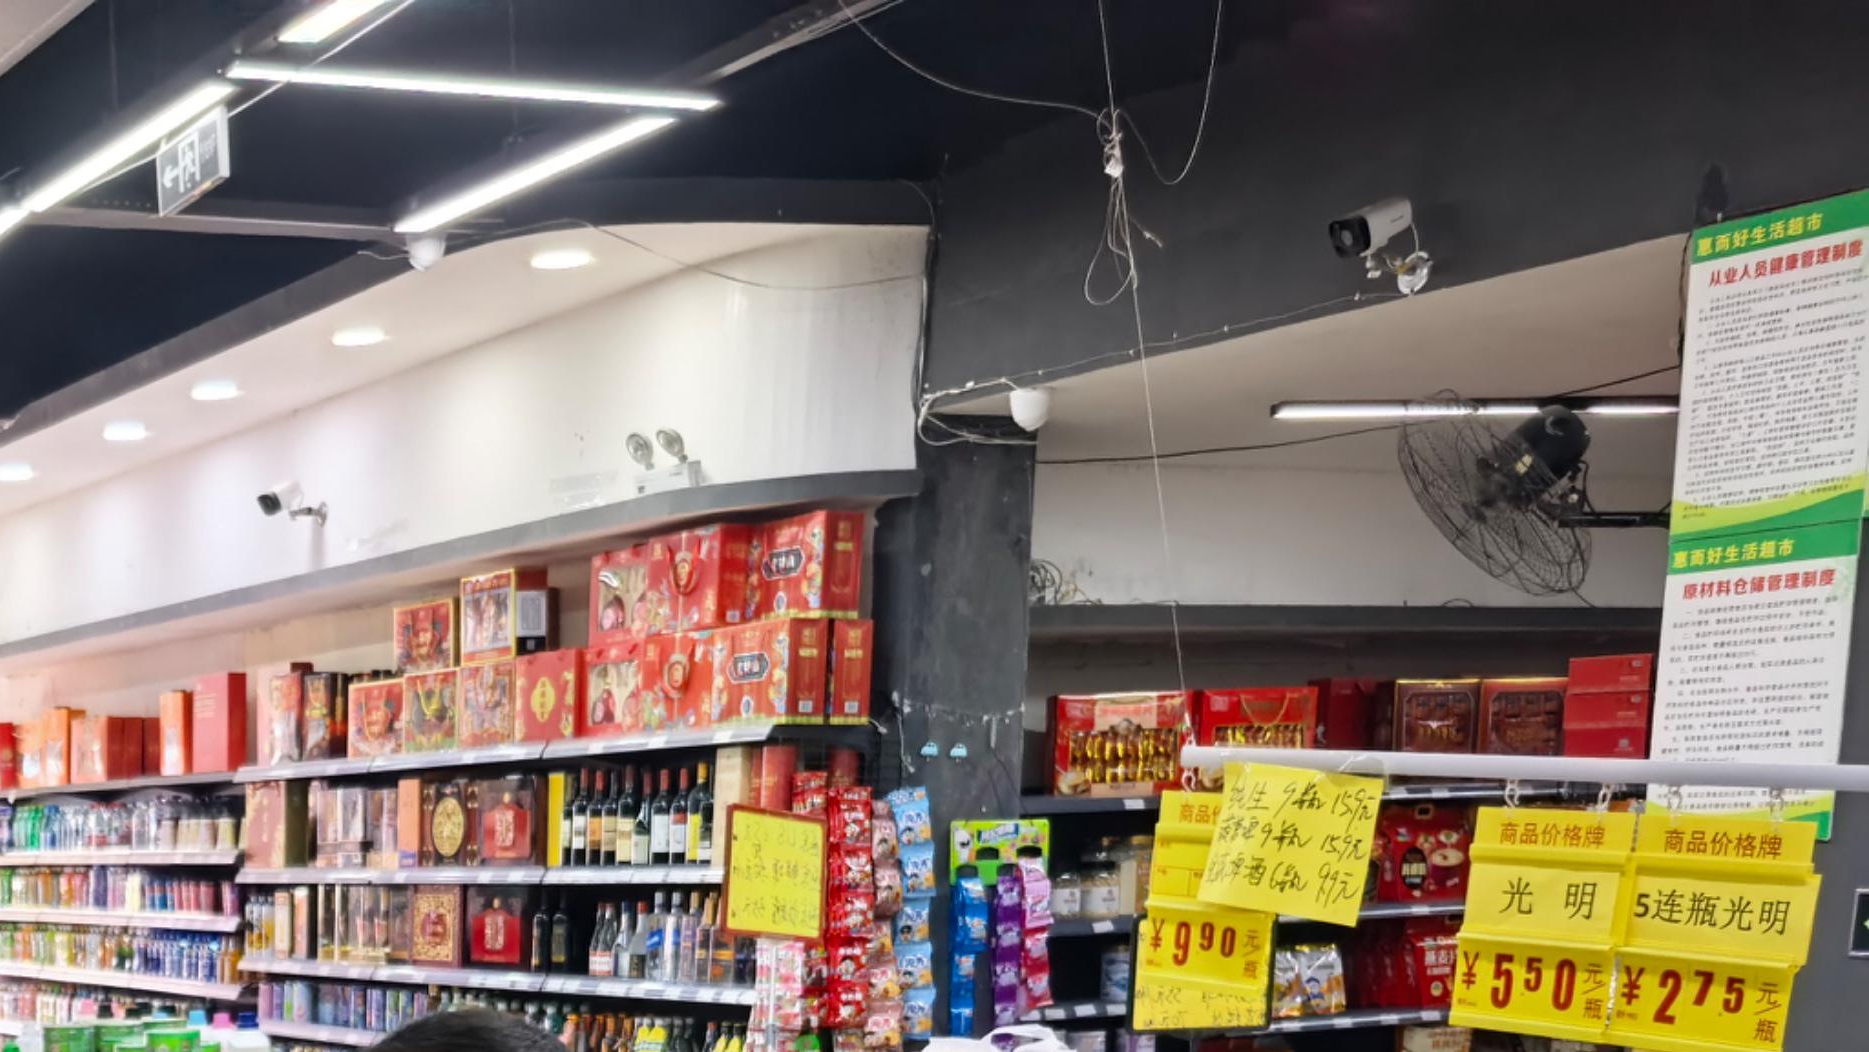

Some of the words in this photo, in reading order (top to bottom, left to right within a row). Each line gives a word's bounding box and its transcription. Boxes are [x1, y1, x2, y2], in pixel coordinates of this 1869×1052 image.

[1709, 239, 1864, 287] 从业人员健康管理制度
[1682, 568, 1836, 601] 原材料仓储管理制度
[1499, 821, 1606, 849] 商品价格牌
[1663, 828, 1784, 859] 商品价格牌
[1632, 888, 1792, 937] 5连瓶光明
